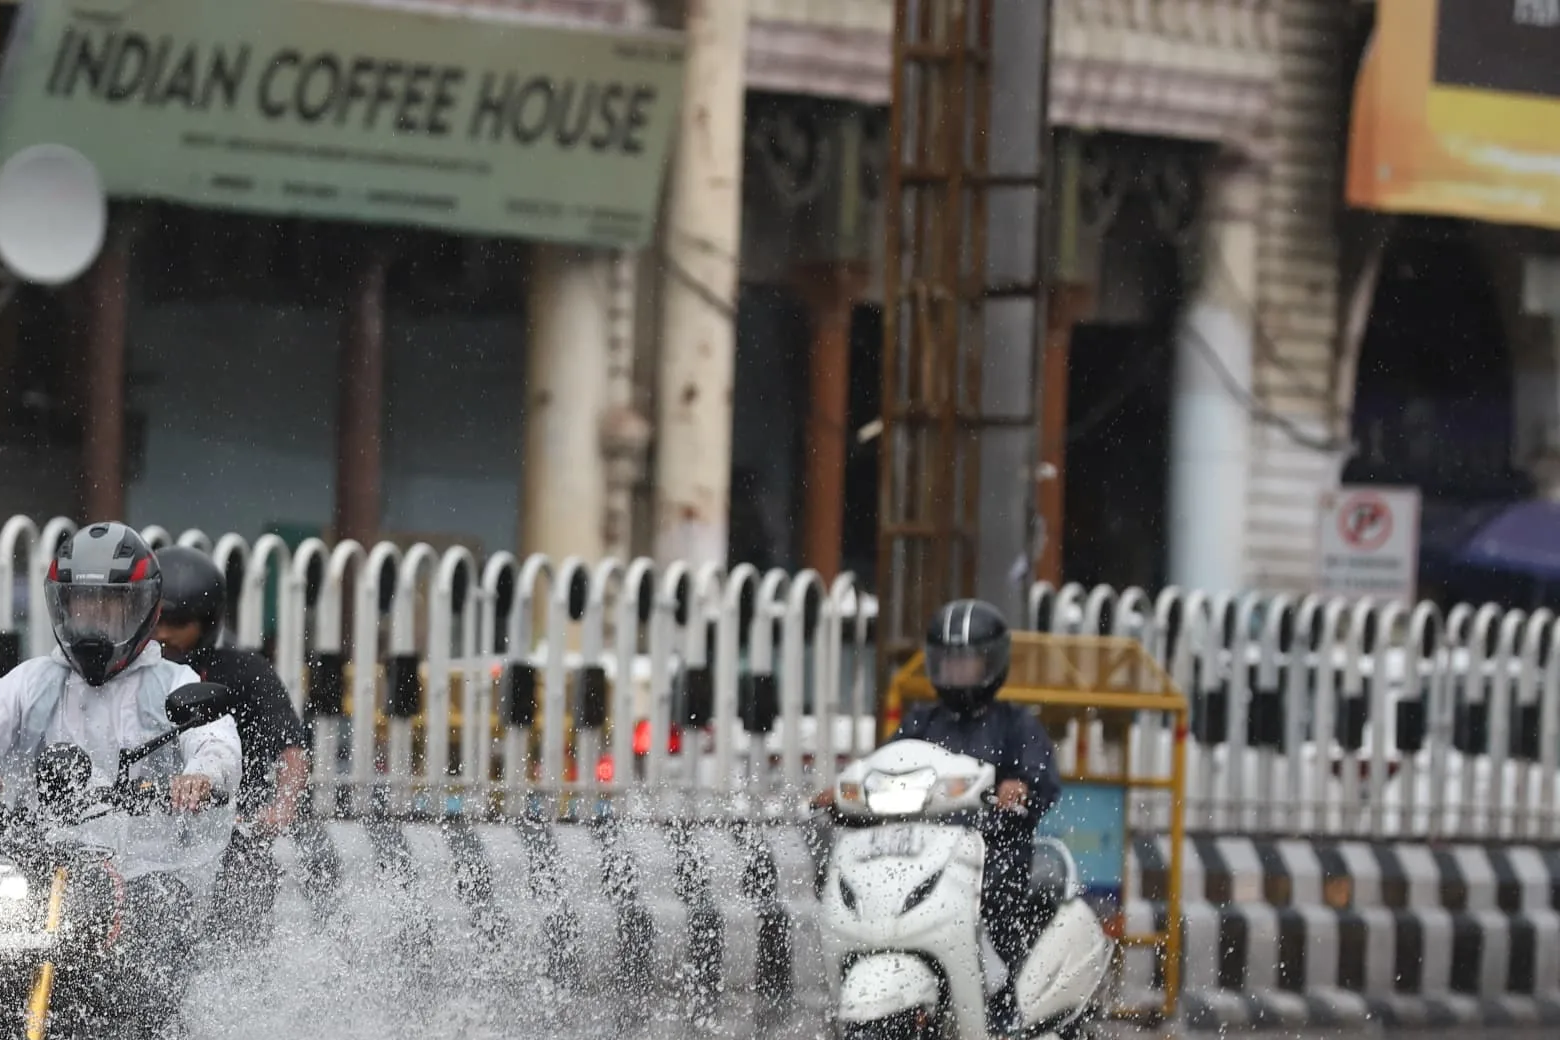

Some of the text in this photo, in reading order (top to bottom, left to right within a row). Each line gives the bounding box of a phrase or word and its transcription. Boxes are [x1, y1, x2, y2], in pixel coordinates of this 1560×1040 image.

[45, 25, 252, 111] INDIAN
[258, 47, 466, 138] COFFEE
[467, 67, 658, 156] HOUSE
